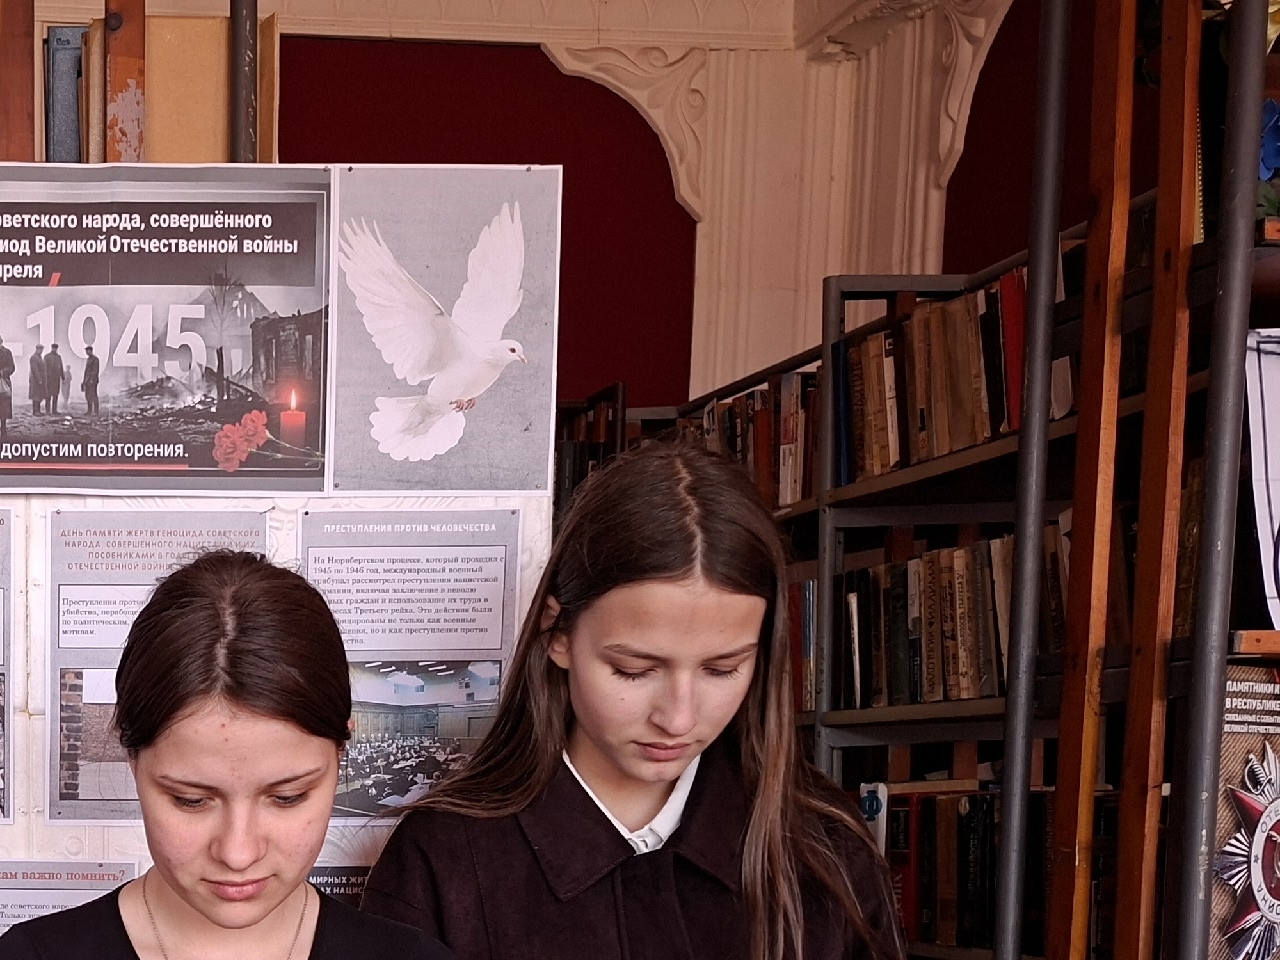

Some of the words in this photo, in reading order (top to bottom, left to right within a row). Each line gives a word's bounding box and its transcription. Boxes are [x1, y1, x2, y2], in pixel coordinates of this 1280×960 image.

[82, 214, 146, 231] народа,
[150, 210, 272, 232] совершённого
[35, 235, 106, 254] Великой
[109, 236, 237, 254] Отечественной
[243, 237, 298, 254] войны
[26, 303, 209, 378] 1945
[0, 441, 82, 461] допустим
[87, 441, 189, 461] повторения.
[60, 529, 83, 538] ДЕНЬ
[86, 529, 123, 537] ПАМЯТИ
[157, 530, 204, 538] ГЕНОЦИДА
[206, 529, 260, 537] СОВЕТСКОГО
[324, 524, 392, 533] ПРЕСТУПЛЕНИЯ
[431, 524, 496, 532] ЧЕЛОВЕЧЕСТВА
[67, 561, 139, 571] ОТЕЧЕСТВЕННОЙ
[1226, 681, 1274, 694] ПАМЯТНИКИ
[1226, 698, 1231, 708] В
[1232, 698, 1280, 711] РЕСПУБЛИКЕ
[21, 871, 62, 881] важно
[66, 869, 125, 882] помнить?
[309, 876, 347, 884] МИРНЫХ
